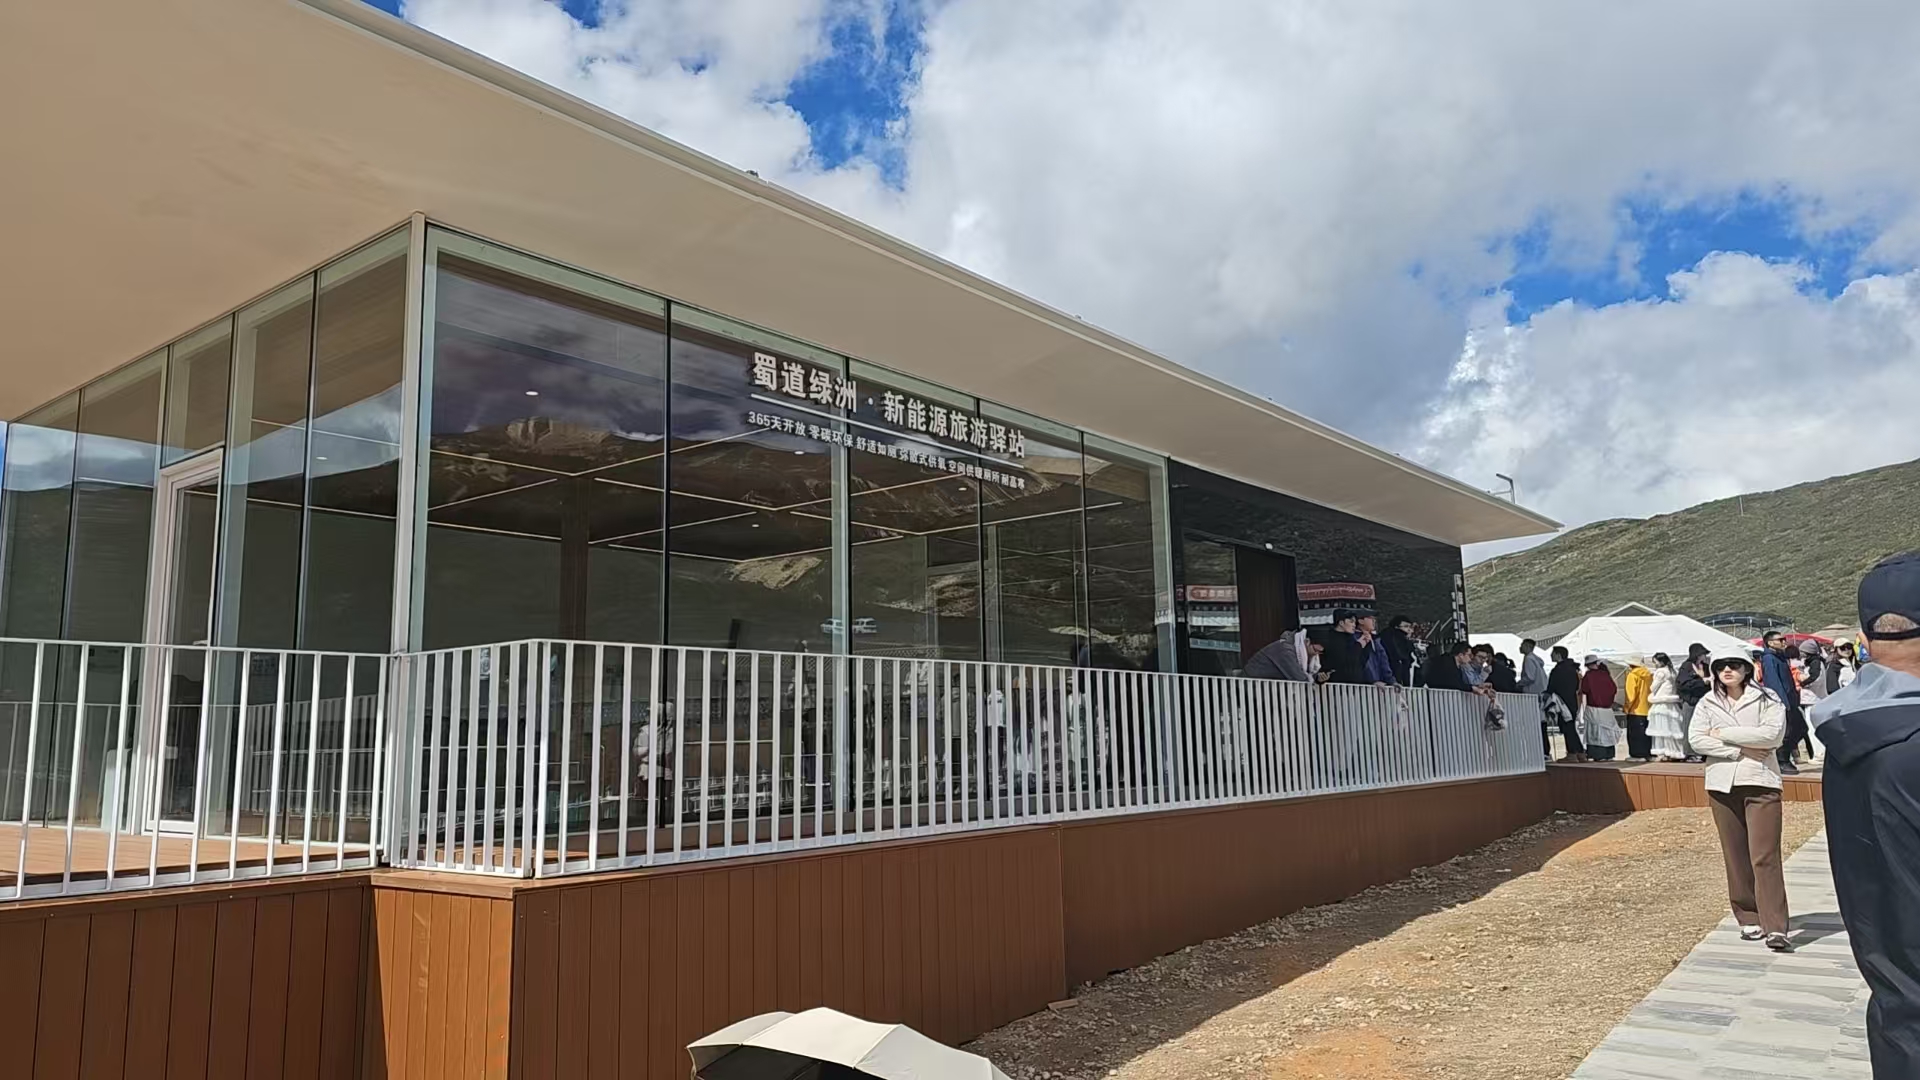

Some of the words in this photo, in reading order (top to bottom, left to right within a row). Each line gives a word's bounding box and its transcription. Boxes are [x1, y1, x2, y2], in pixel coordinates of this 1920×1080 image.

[748, 411, 806, 436] 365天开放
[809, 424, 854, 447] 零碳环保
